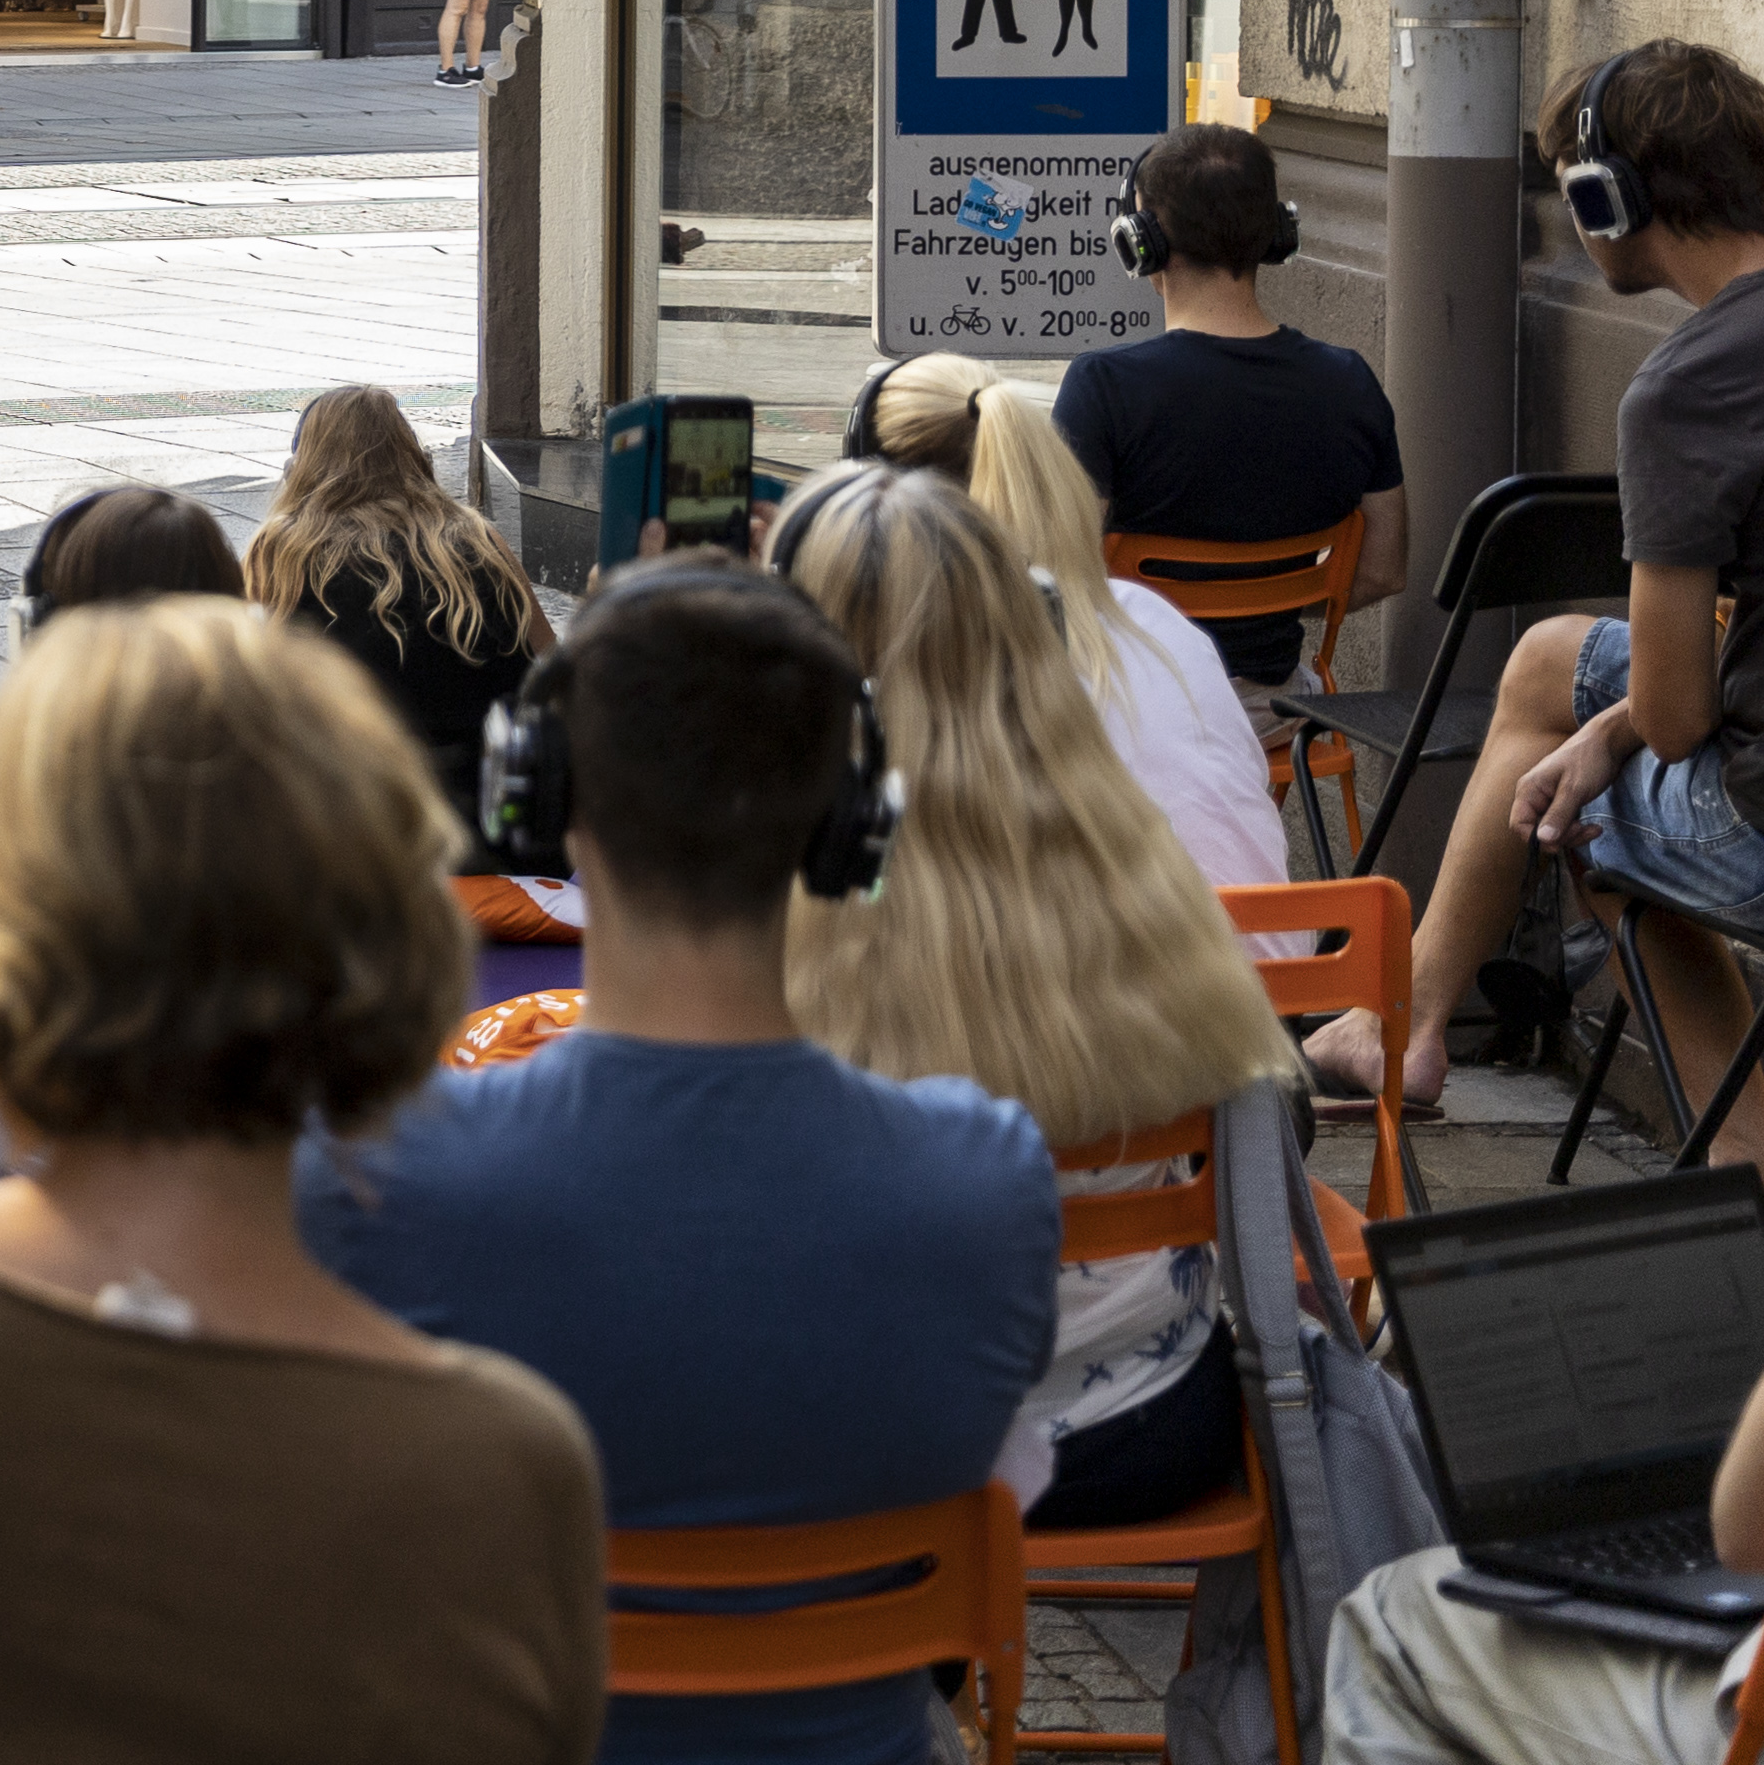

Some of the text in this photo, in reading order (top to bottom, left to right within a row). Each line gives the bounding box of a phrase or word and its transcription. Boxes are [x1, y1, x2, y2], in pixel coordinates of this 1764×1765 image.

[894, 229, 1108, 262] Fahrzeugen bis
[965, 276, 988, 296] v.
[909, 317, 934, 337] u.
[1001, 317, 1025, 337] v.
